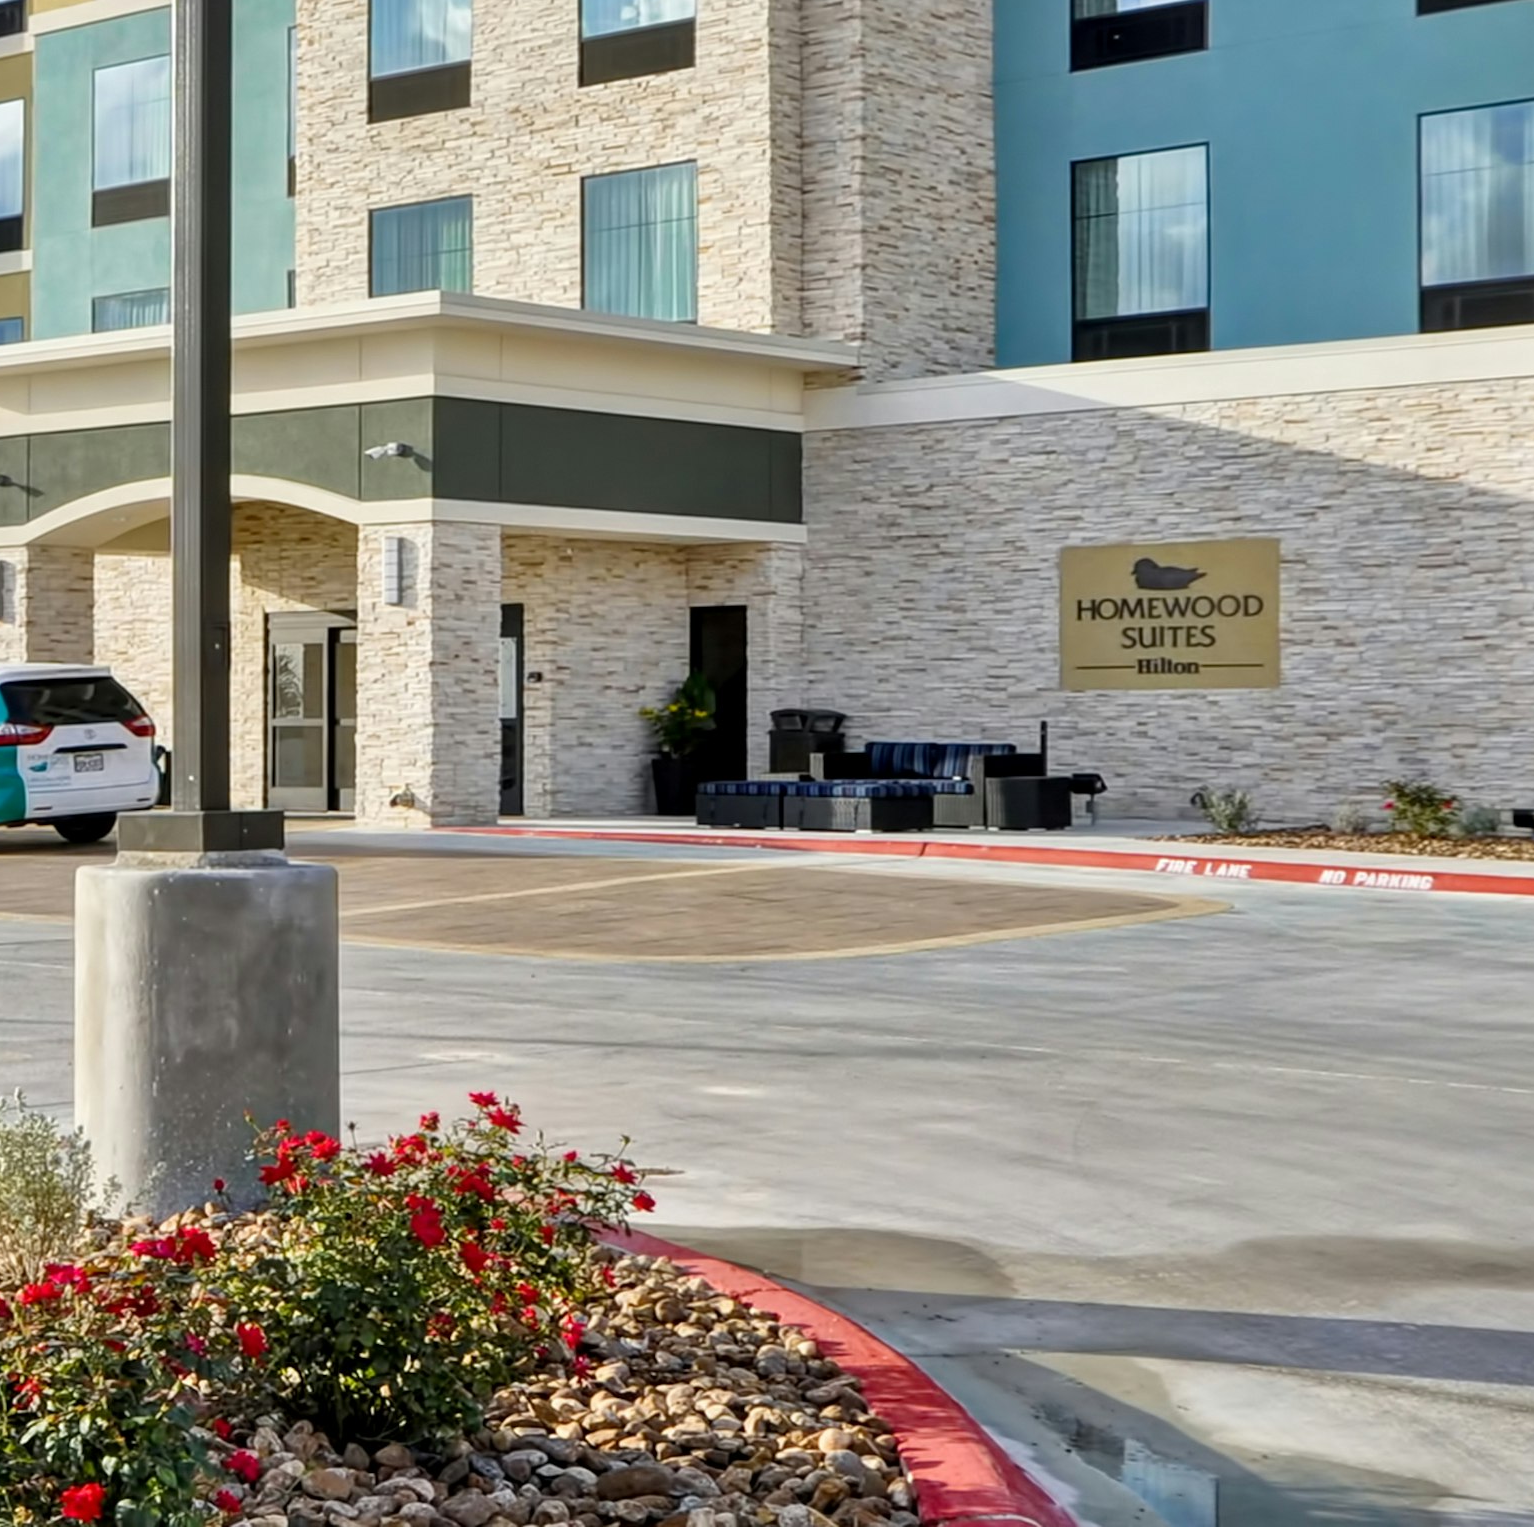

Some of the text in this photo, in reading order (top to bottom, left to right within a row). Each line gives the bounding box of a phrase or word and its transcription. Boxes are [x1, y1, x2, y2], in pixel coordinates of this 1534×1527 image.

[1076, 594, 1264, 621] HOMEWOOD
[1120, 625, 1216, 649] SUITES
[1136, 657, 1200, 675] Hilton
[1155, 858, 1434, 890] FIRE LANE NO PARKING
